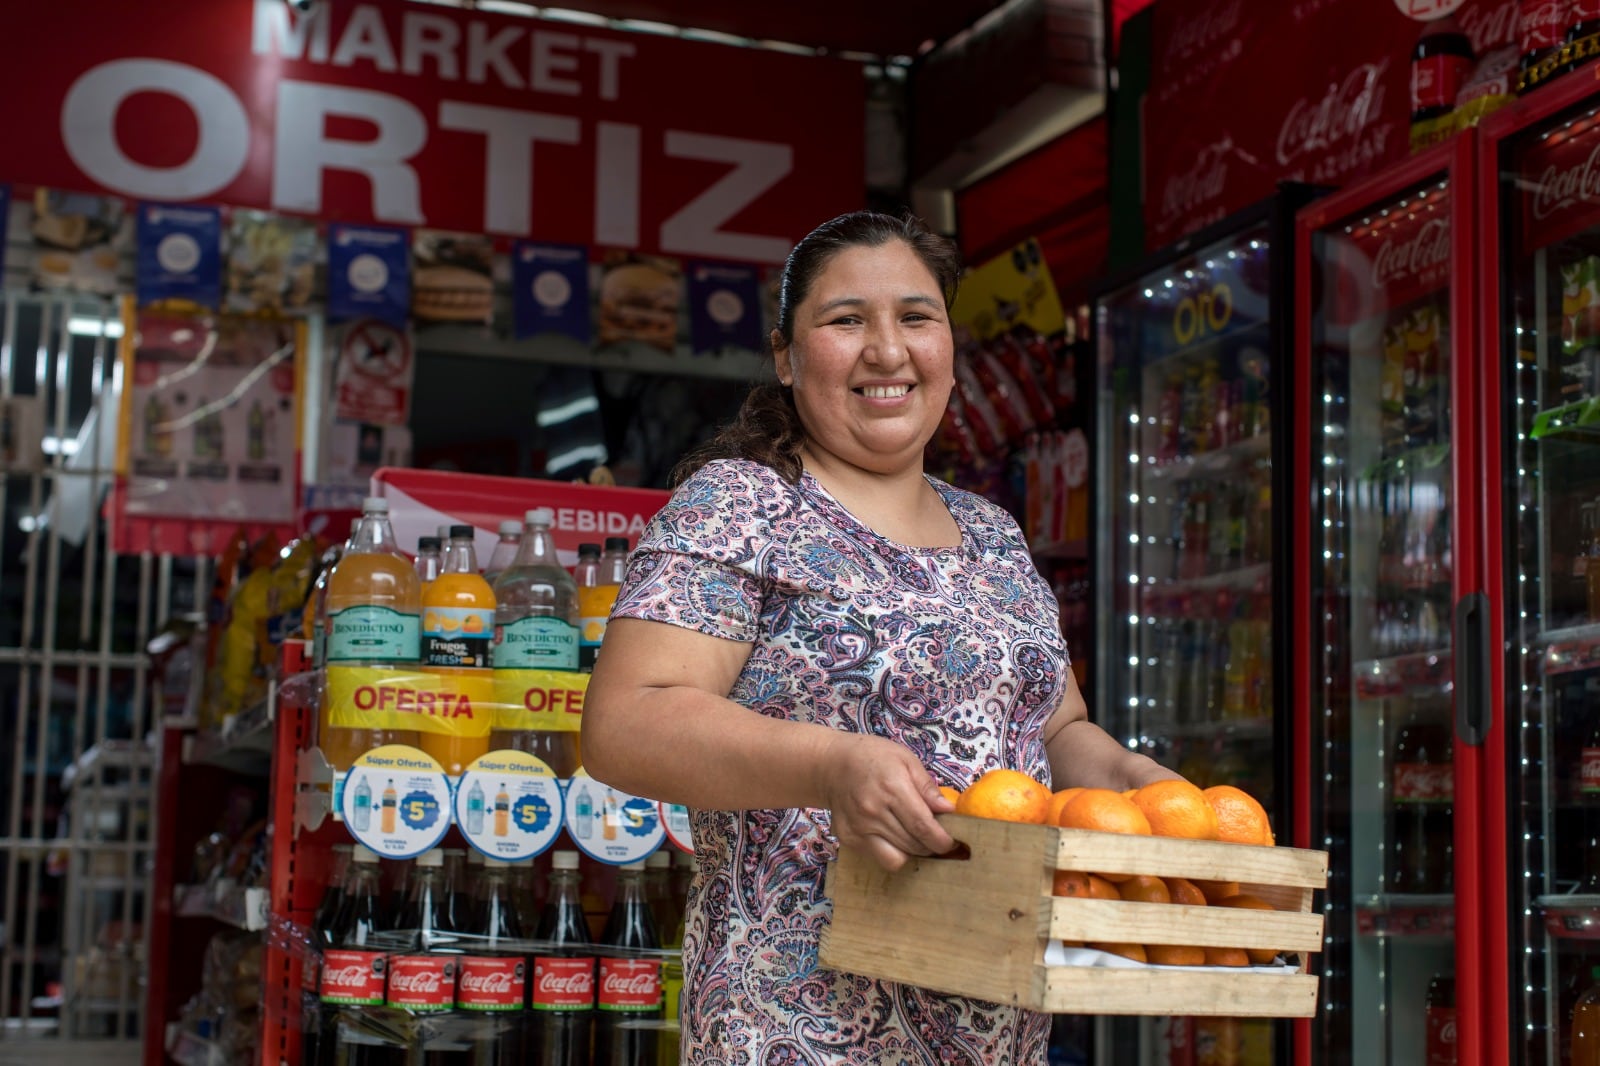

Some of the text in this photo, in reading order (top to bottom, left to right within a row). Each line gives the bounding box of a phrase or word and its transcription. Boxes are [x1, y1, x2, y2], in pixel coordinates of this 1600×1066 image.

[252, 0, 638, 101] MARKET
[60, 57, 794, 262] ORTIZ
[334, 623, 404, 635] BENEDICTINO
[506, 632, 574, 645] BENEDICTINO
[353, 685, 474, 720] OFERTA
[523, 687, 584, 714] OFE
[396, 758, 432, 769] Ofertas
[509, 763, 544, 773] Ofertas
[389, 970, 441, 993] Coca-Cola
[460, 971, 513, 993] Coca-Cola
[540, 972, 591, 993] Coca-Cola
[604, 973, 656, 994] Coca-Cola
